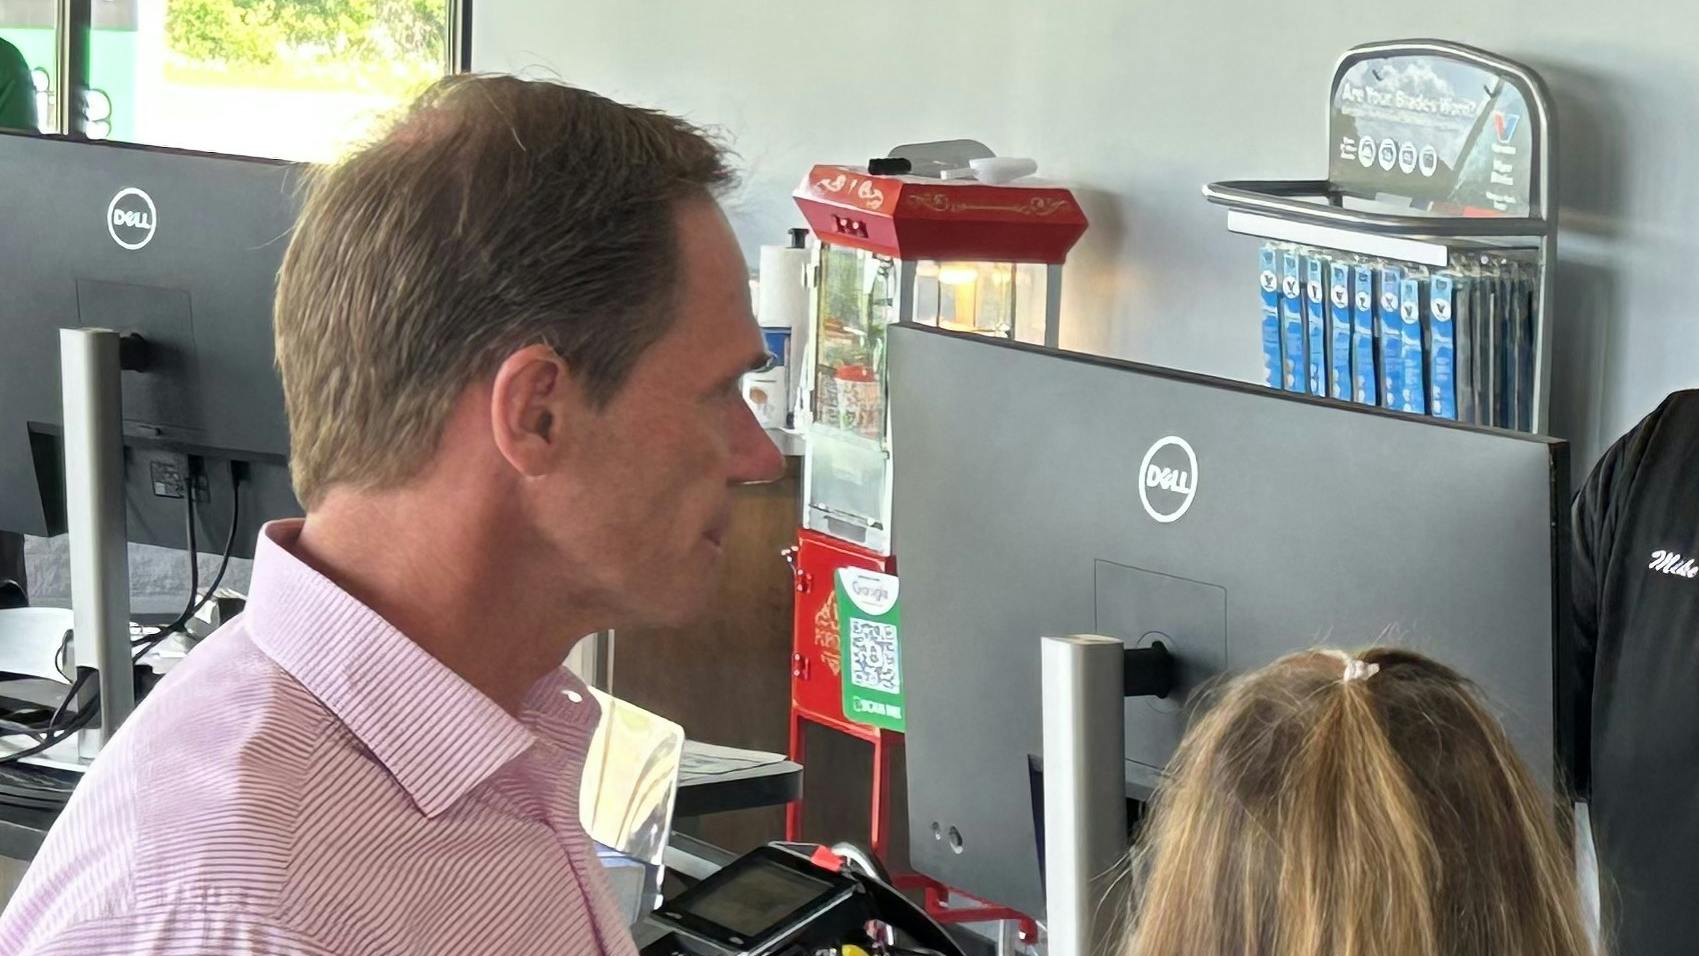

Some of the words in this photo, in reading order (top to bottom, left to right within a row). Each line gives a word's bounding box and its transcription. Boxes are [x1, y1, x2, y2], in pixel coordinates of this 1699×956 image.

[113, 208, 151, 230] DELL
[1146, 463, 1190, 495] DELL
[1648, 549, 1699, 579] Mike
